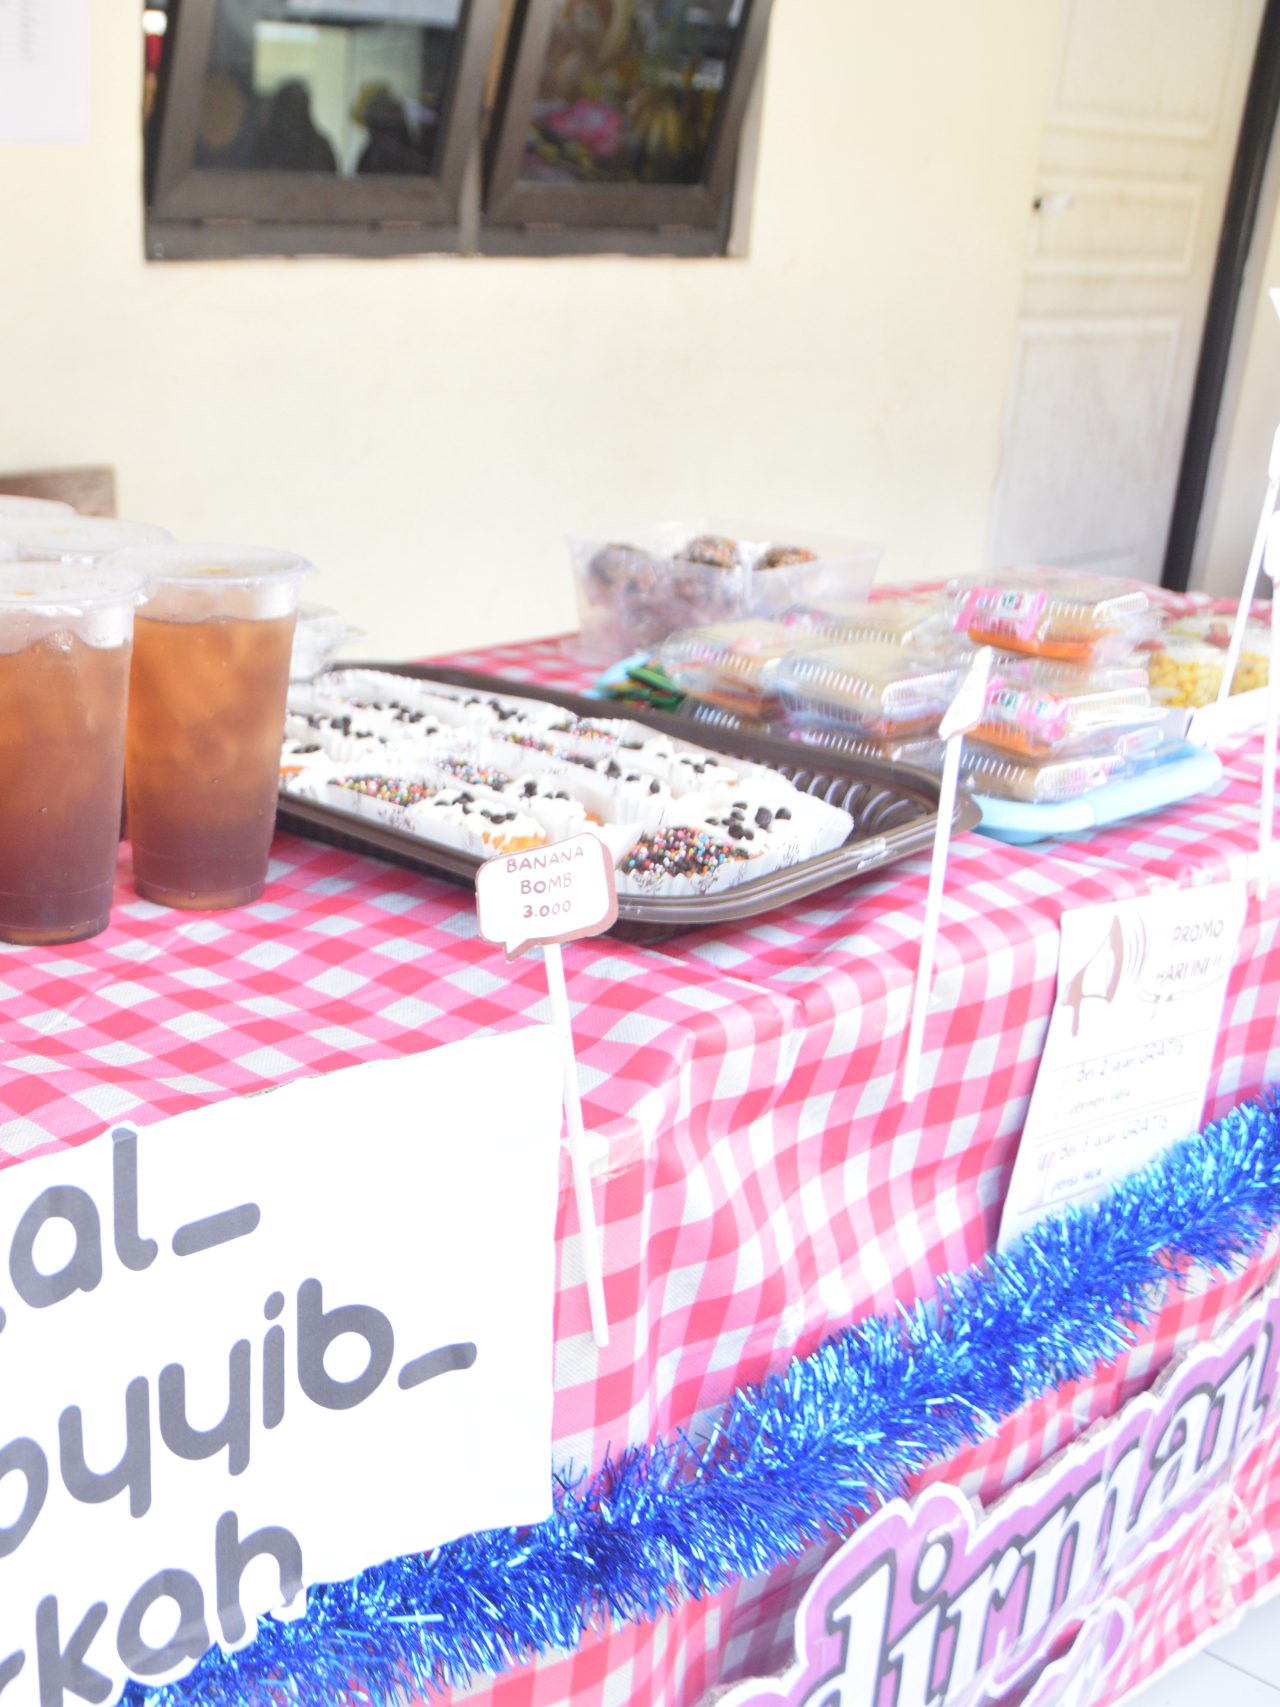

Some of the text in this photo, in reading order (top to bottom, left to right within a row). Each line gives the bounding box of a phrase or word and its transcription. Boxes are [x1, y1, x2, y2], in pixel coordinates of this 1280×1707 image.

[506, 846, 584, 873] BANANA
[520, 872, 573, 895] BOMB
[523, 900, 572, 919] 3.000
[1173, 919, 1224, 943] PROMO
